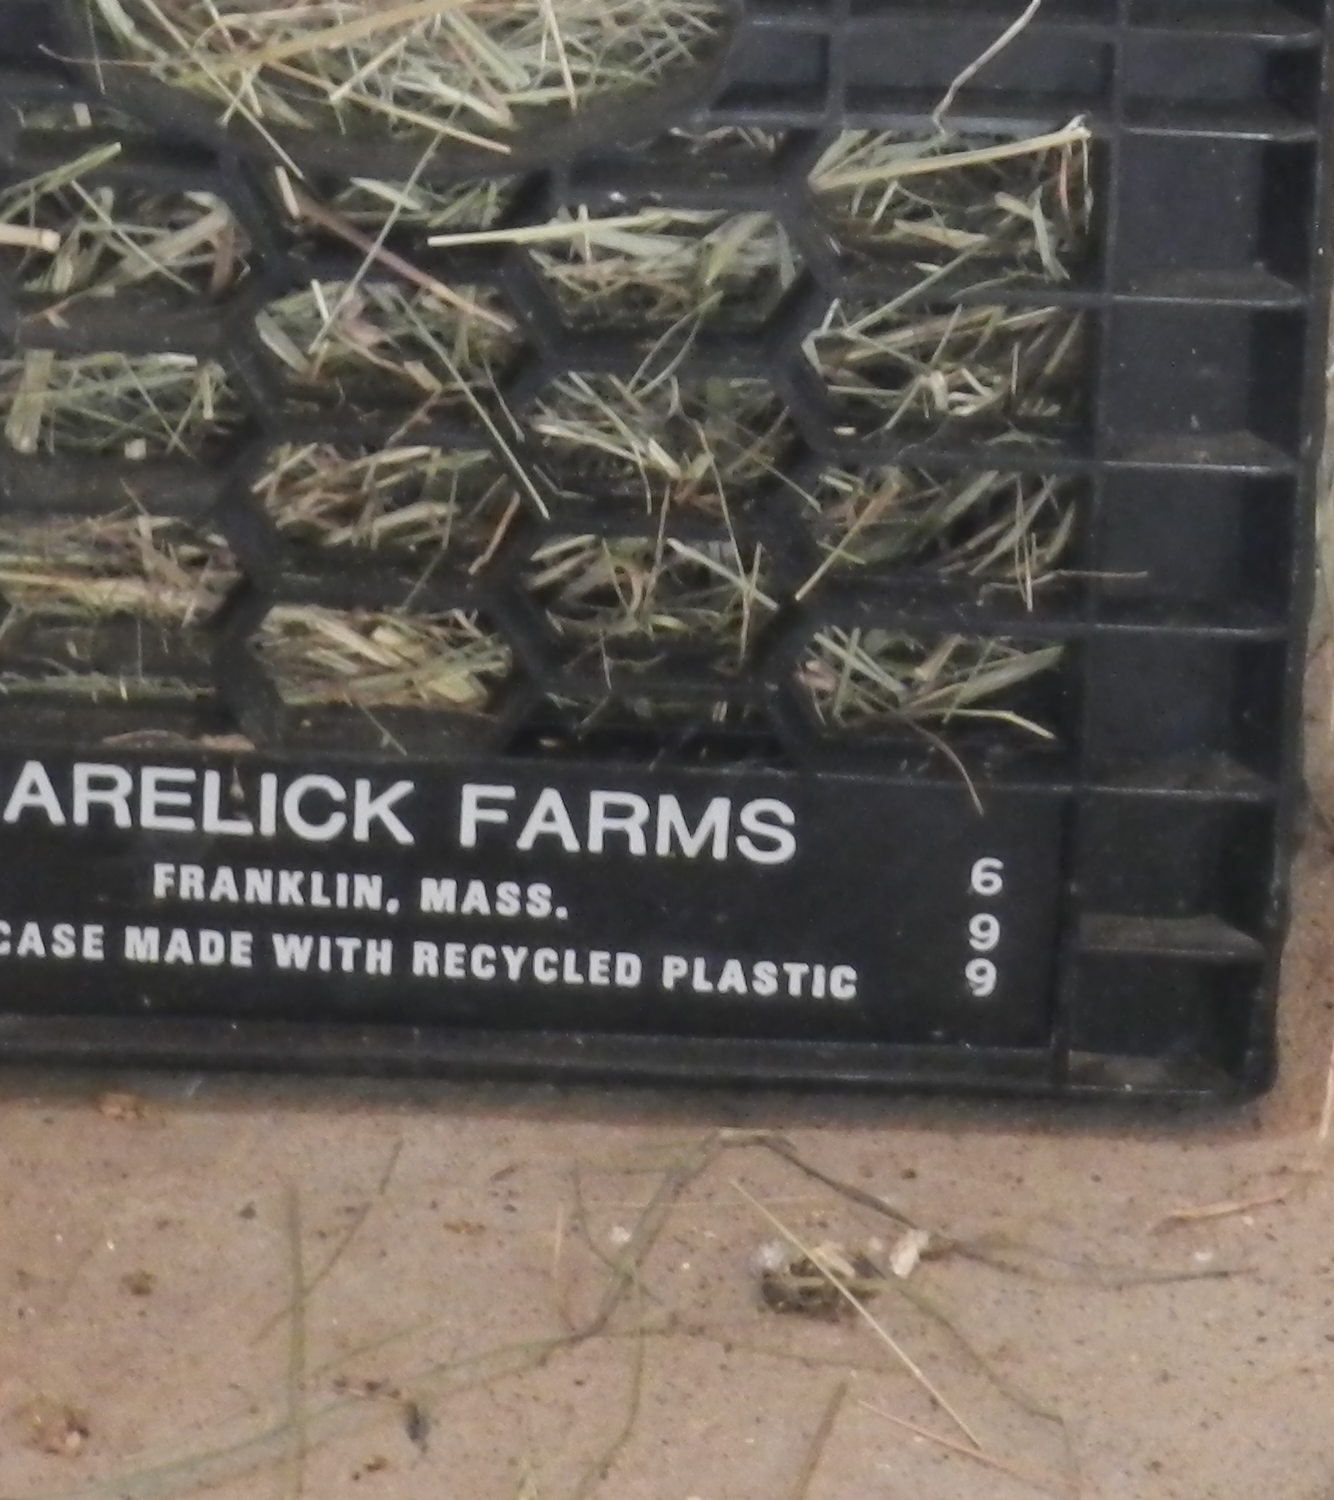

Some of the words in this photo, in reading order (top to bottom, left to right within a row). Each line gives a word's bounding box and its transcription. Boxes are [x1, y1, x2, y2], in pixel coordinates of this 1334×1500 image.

[459, 783, 797, 865] FARMS
[153, 862, 400, 915] FRANKLIN,
[419, 877, 569, 920] MASS.
[124, 925, 254, 968] MADE
[271, 933, 393, 976] WITH
[412, 940, 643, 988] RECYCLED
[661, 954, 858, 1001] PLASTIC
